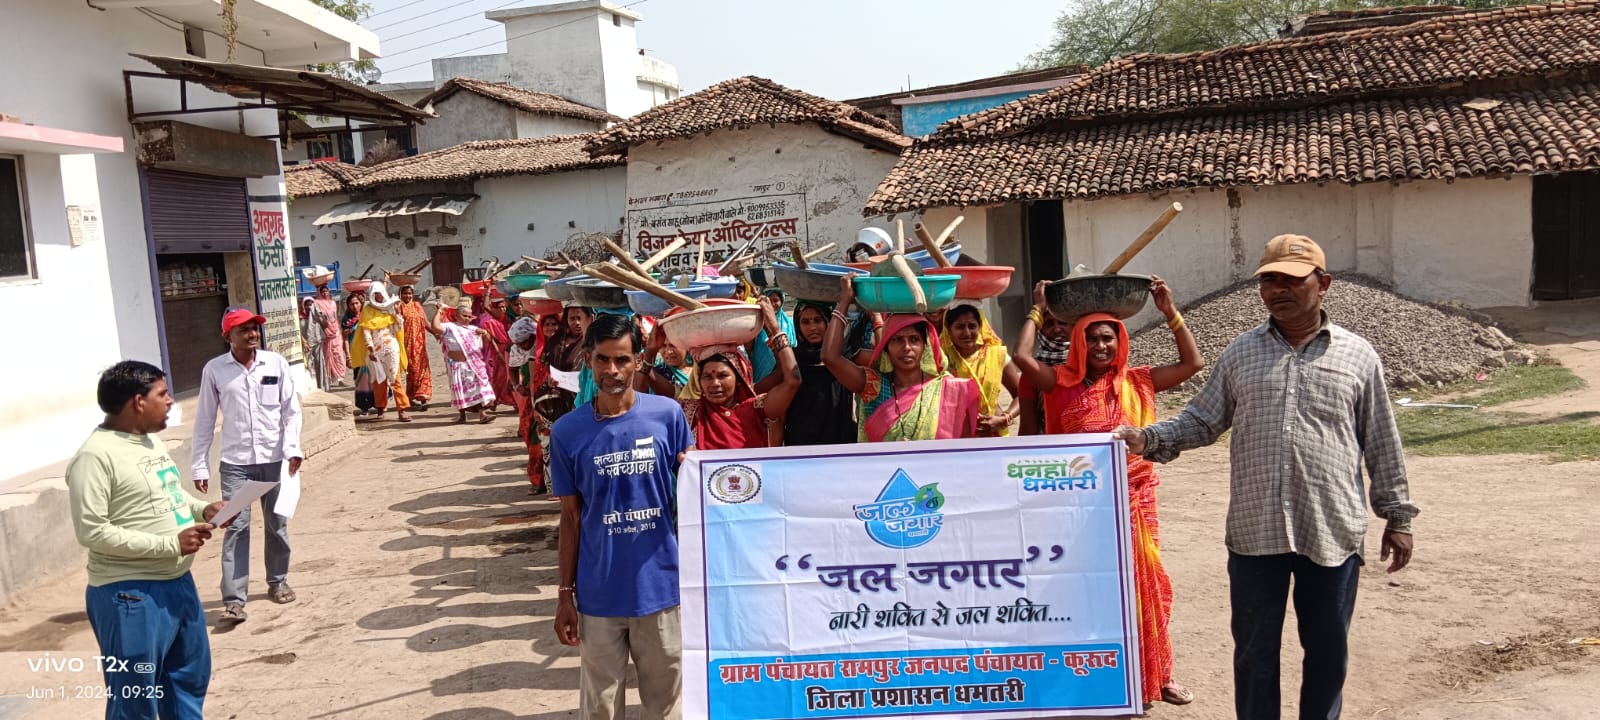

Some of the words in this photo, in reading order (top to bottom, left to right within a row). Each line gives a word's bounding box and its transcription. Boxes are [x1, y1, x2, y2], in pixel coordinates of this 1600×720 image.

[253, 209, 286, 243] अनुग्रह
[637, 230, 677, 251] विजन
[712, 218, 799, 243] ऑप्टिकल्स
[1023, 470, 1097, 492] धमतरी
[885, 513, 944, 532] जगार
[829, 602, 871, 631] नारी
[873, 601, 926, 629] शक्ति
[931, 600, 951, 627] से
[955, 605, 992, 626] जल
[720, 664, 761, 683] ग्राम
[766, 658, 836, 681] पंचायत
[839, 657, 900, 682] रामपुर
[904, 655, 970, 676] जनपद
[974, 649, 1045, 672] पंचायत
[806, 686, 867, 711] जिला
[870, 685, 951, 711] प्रशासन
[955, 678, 1026, 704] धमतरी
